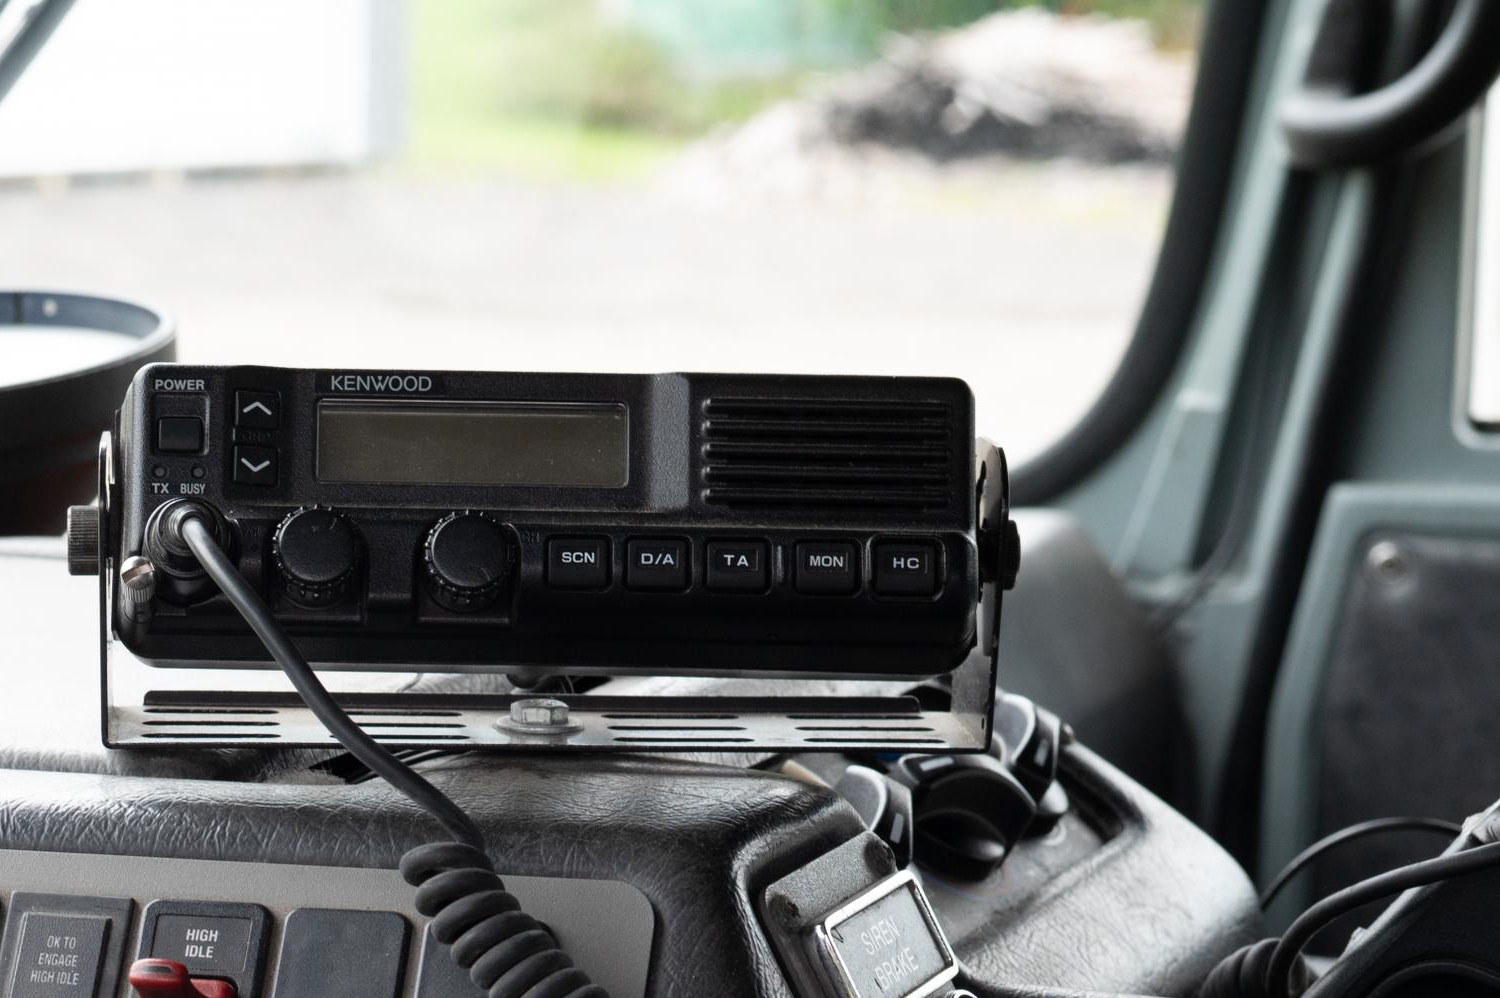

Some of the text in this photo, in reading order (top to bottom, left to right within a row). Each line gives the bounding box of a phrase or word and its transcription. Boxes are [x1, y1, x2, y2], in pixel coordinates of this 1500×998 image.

[154, 379, 205, 391] POWER
[330, 375, 432, 392] KENWOOD
[152, 483, 206, 495] TX BUSY
[561, 551, 596, 564] SCN
[641, 553, 675, 565] D/A
[723, 554, 749, 567] TA
[809, 555, 844, 568] MON
[892, 557, 920, 569] HC
[185, 929, 219, 943] HIGH
[860, 914, 901, 956] SIREN
[47, 936, 77, 949] OK TO
[184, 945, 215, 959] IDLE
[38, 953, 79, 968] ENGAGE
[874, 946, 919, 990] BRAKE
[30, 970, 80, 986] HIGH IDLE
